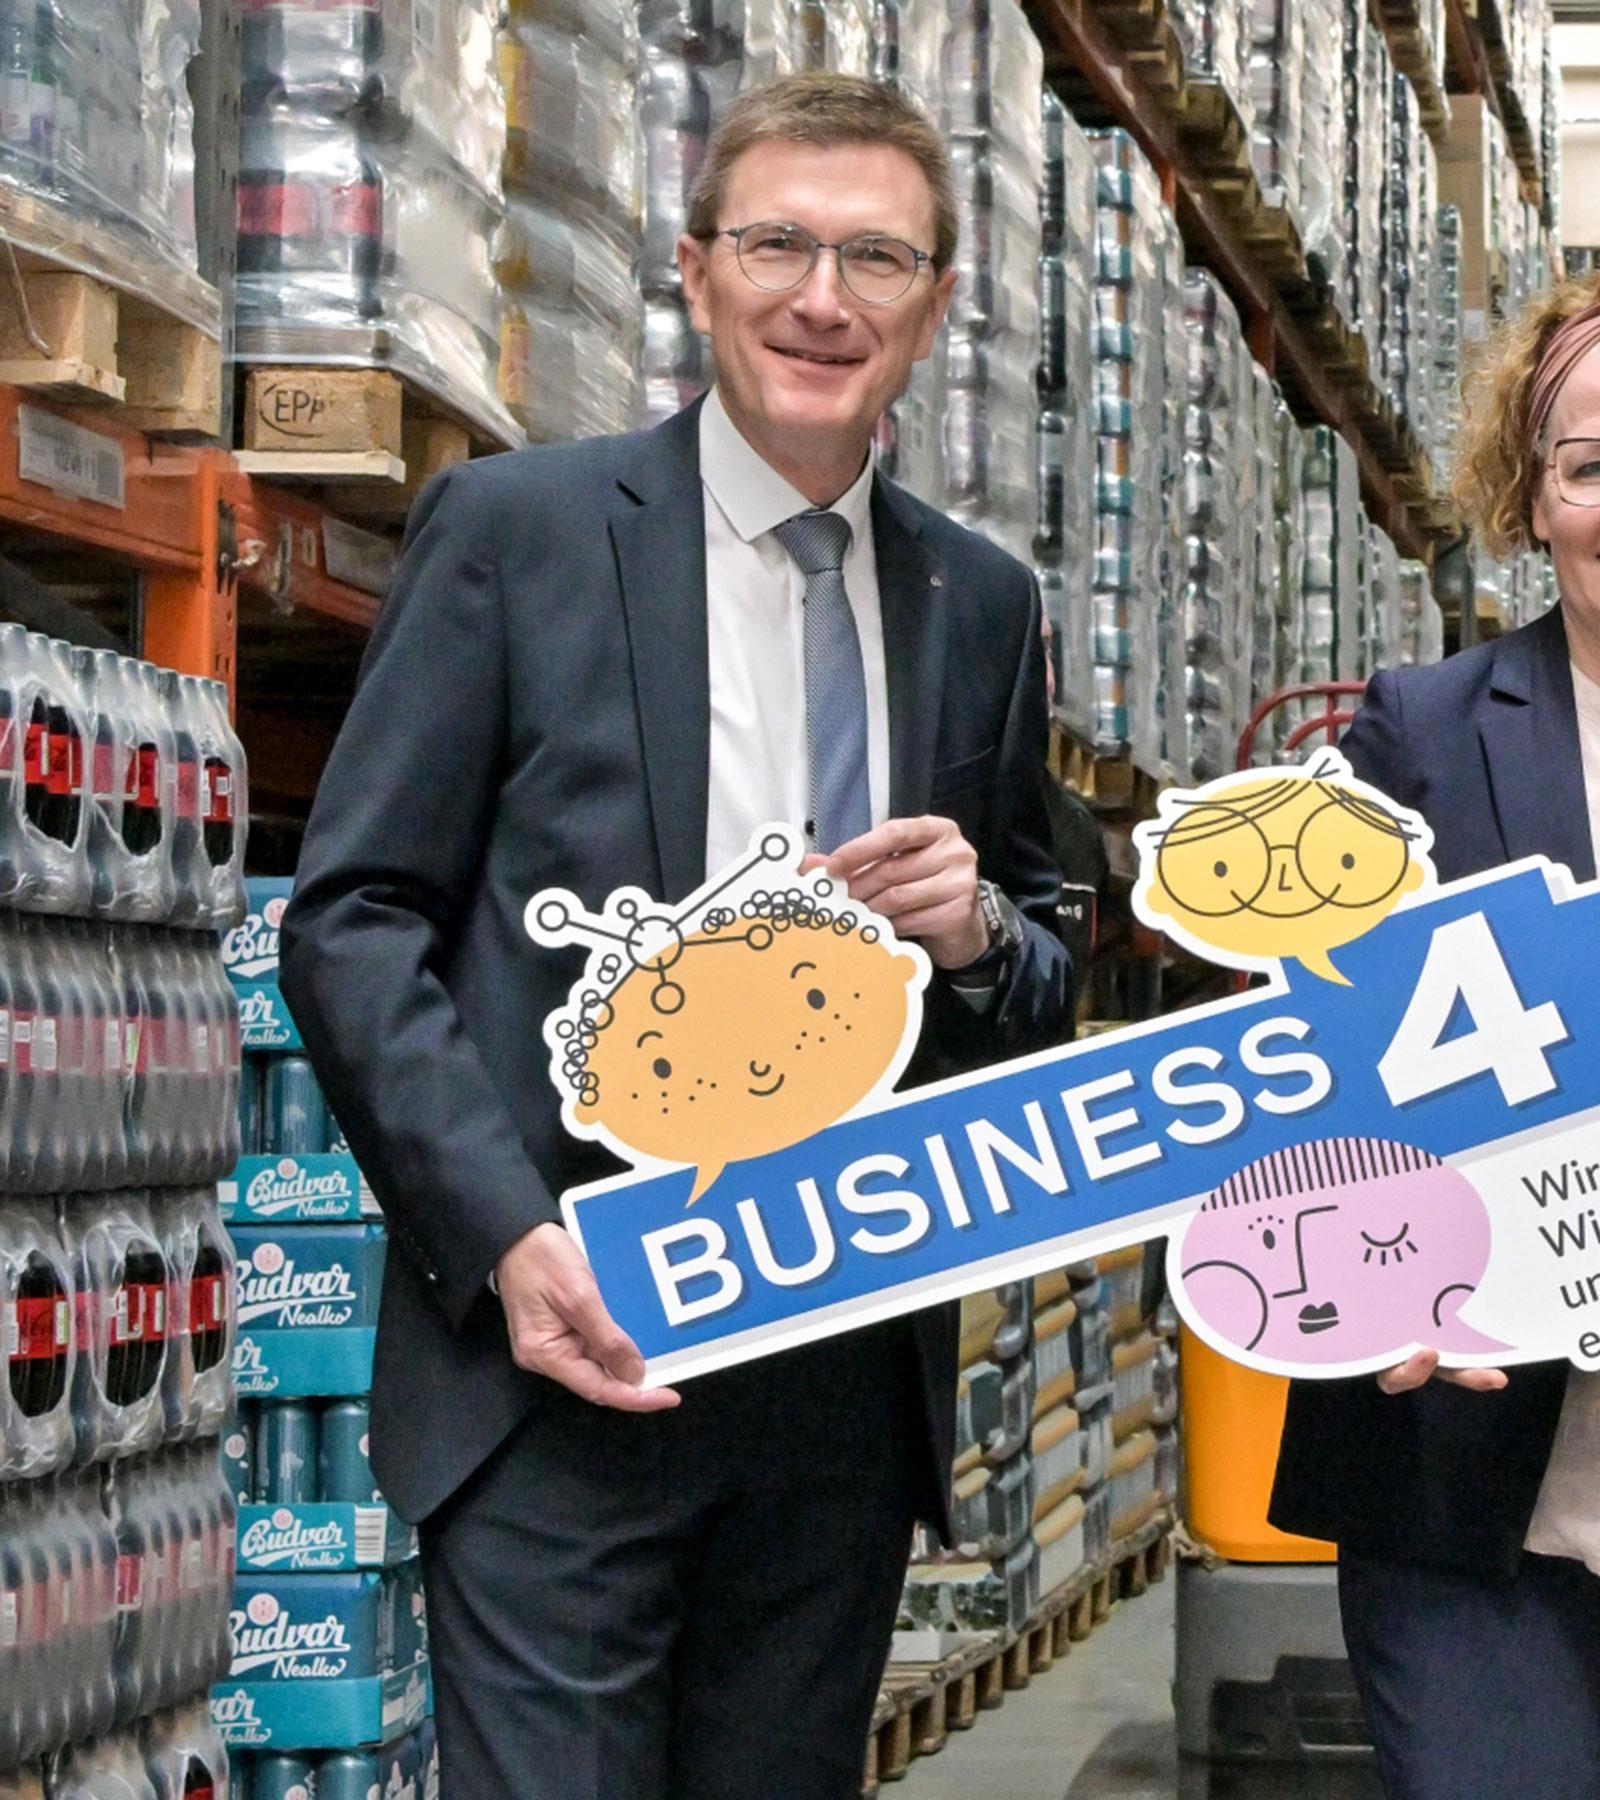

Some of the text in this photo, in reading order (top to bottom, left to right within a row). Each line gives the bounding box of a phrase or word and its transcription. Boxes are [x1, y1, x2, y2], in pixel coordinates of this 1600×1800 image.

[641, 1016, 1332, 1326] BUSINESS
[1377, 911, 1569, 1106] 4
[246, 1168, 352, 1208] Budvar
[296, 1201, 349, 1217] Nealko
[278, 1304, 352, 1327] Nealko
[240, 1518, 348, 1558] Budvar
[272, 1656, 347, 1679] Nealko
